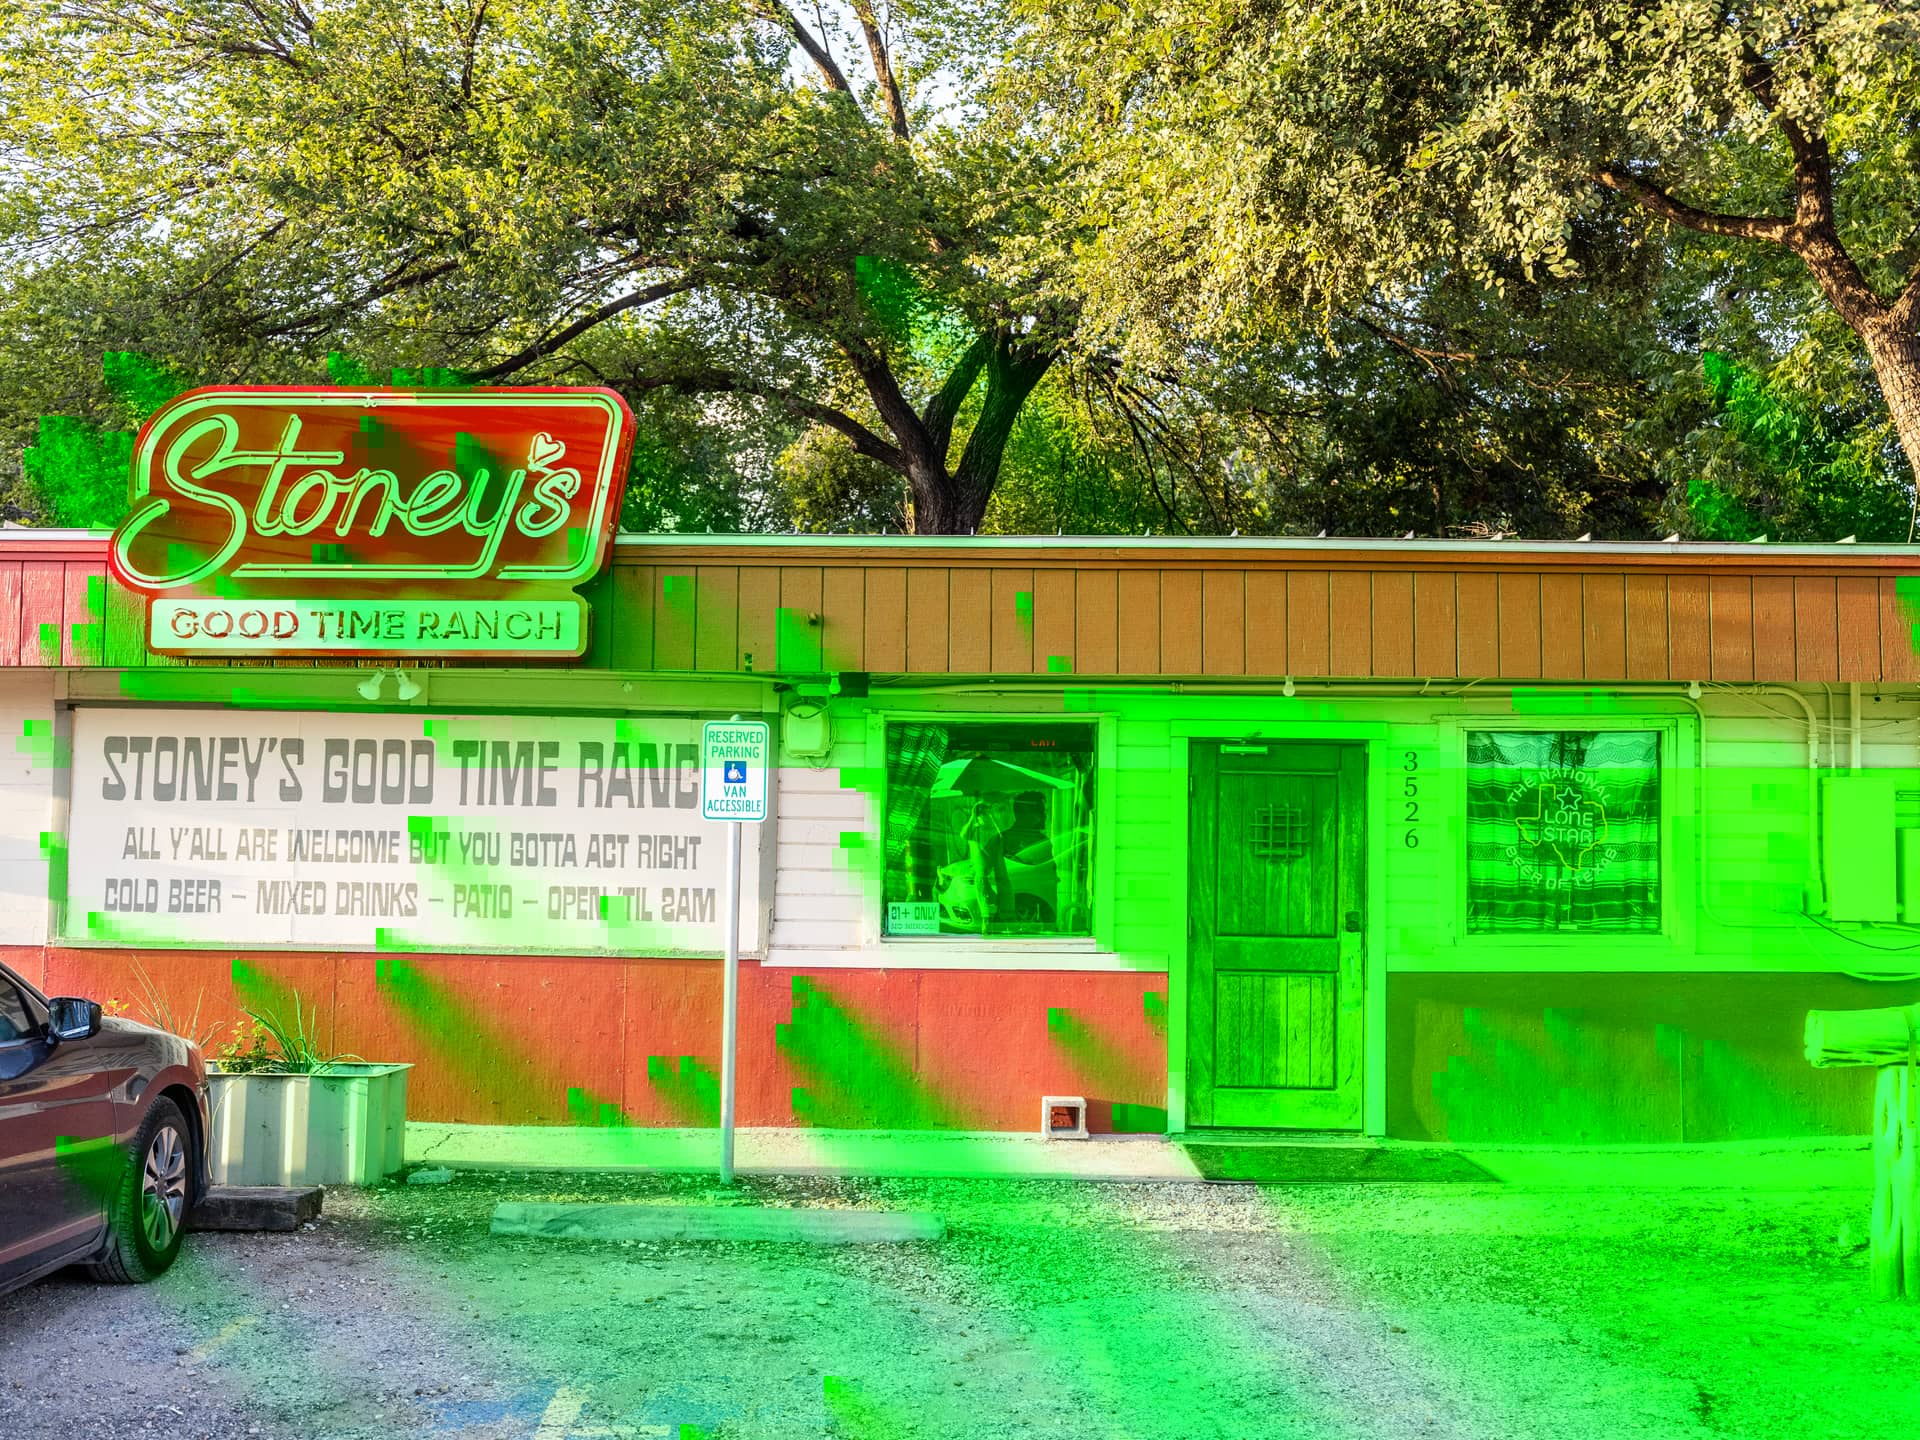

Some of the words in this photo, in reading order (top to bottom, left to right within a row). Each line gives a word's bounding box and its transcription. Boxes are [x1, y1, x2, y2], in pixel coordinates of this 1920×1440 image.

[113, 414, 581, 589] Stoney's
[170, 608, 299, 639] GOOD
[310, 610, 405, 640] TIME
[416, 610, 561, 640] RANCH
[708, 731, 763, 743] RESERVED
[711, 746, 760, 758] PARKING
[102, 736, 304, 802] STONEY'S
[322, 738, 434, 804] GOOD
[453, 740, 560, 807] TIME
[577, 741, 699, 809] RANC
[1507, 776, 1537, 803] THE
[1539, 768, 1611, 807] NATIONAL
[707, 799, 762, 812] ACCESSIBLE
[723, 785, 747, 798] VAN
[1403, 751, 1419, 849] 3526
[122, 827, 160, 860] ALL
[170, 828, 227, 861] Y'ALL
[235, 828, 278, 861] ARE
[287, 829, 401, 863] WELCOME
[409, 832, 451, 864] BUT
[459, 832, 500, 865] YOU
[510, 832, 577, 868] GOTTA
[585, 833, 630, 868] ACT
[637, 834, 702, 870] RIGHT
[1543, 827, 1593, 845] STAR
[1505, 845, 1543, 884] BEER
[1545, 878, 1568, 890] OF
[104, 878, 159, 913] COLD
[168, 879, 222, 913] BEER
[256, 880, 327, 915] MIXED
[335, 881, 418, 917] DRINKS
[453, 884, 512, 918] PATIO
[547, 886, 608, 921] OPEN
[617, 887, 652, 922] 'TIL
[661, 887, 716, 923] 2AM
[914, 906, 936, 920] ONLY
